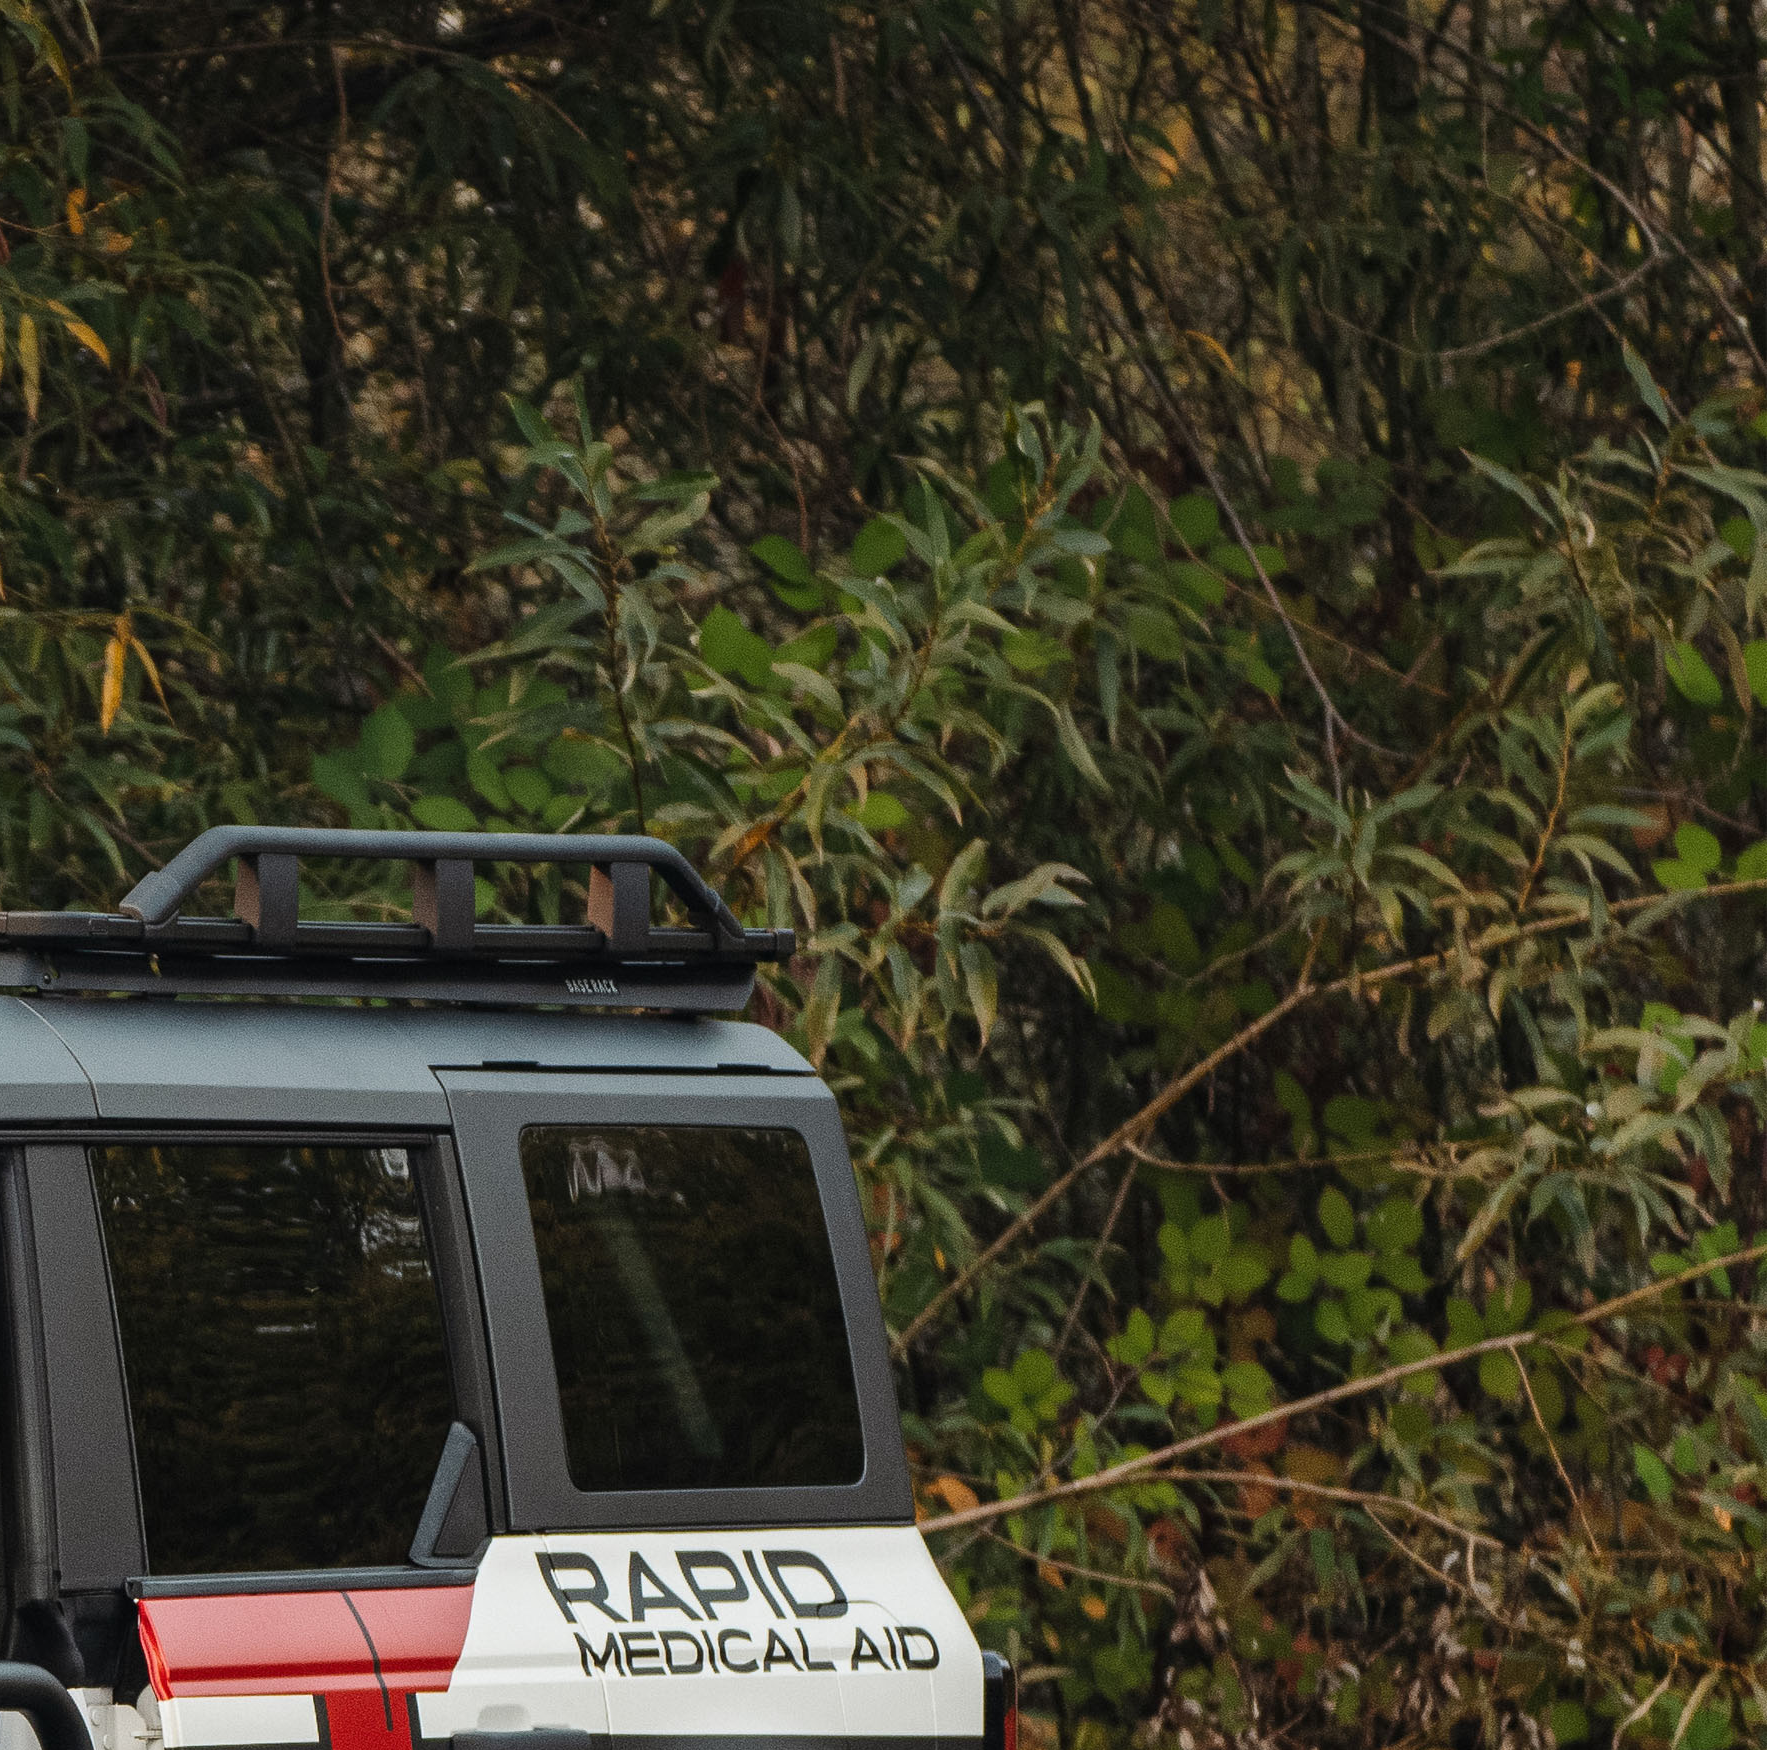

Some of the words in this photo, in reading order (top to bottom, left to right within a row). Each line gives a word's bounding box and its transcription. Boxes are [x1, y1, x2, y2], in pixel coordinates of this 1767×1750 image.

[535, 1550, 849, 1624] RAPID
[573, 1627, 837, 1677] MEDICAL
[851, 1626, 940, 1671] AID
